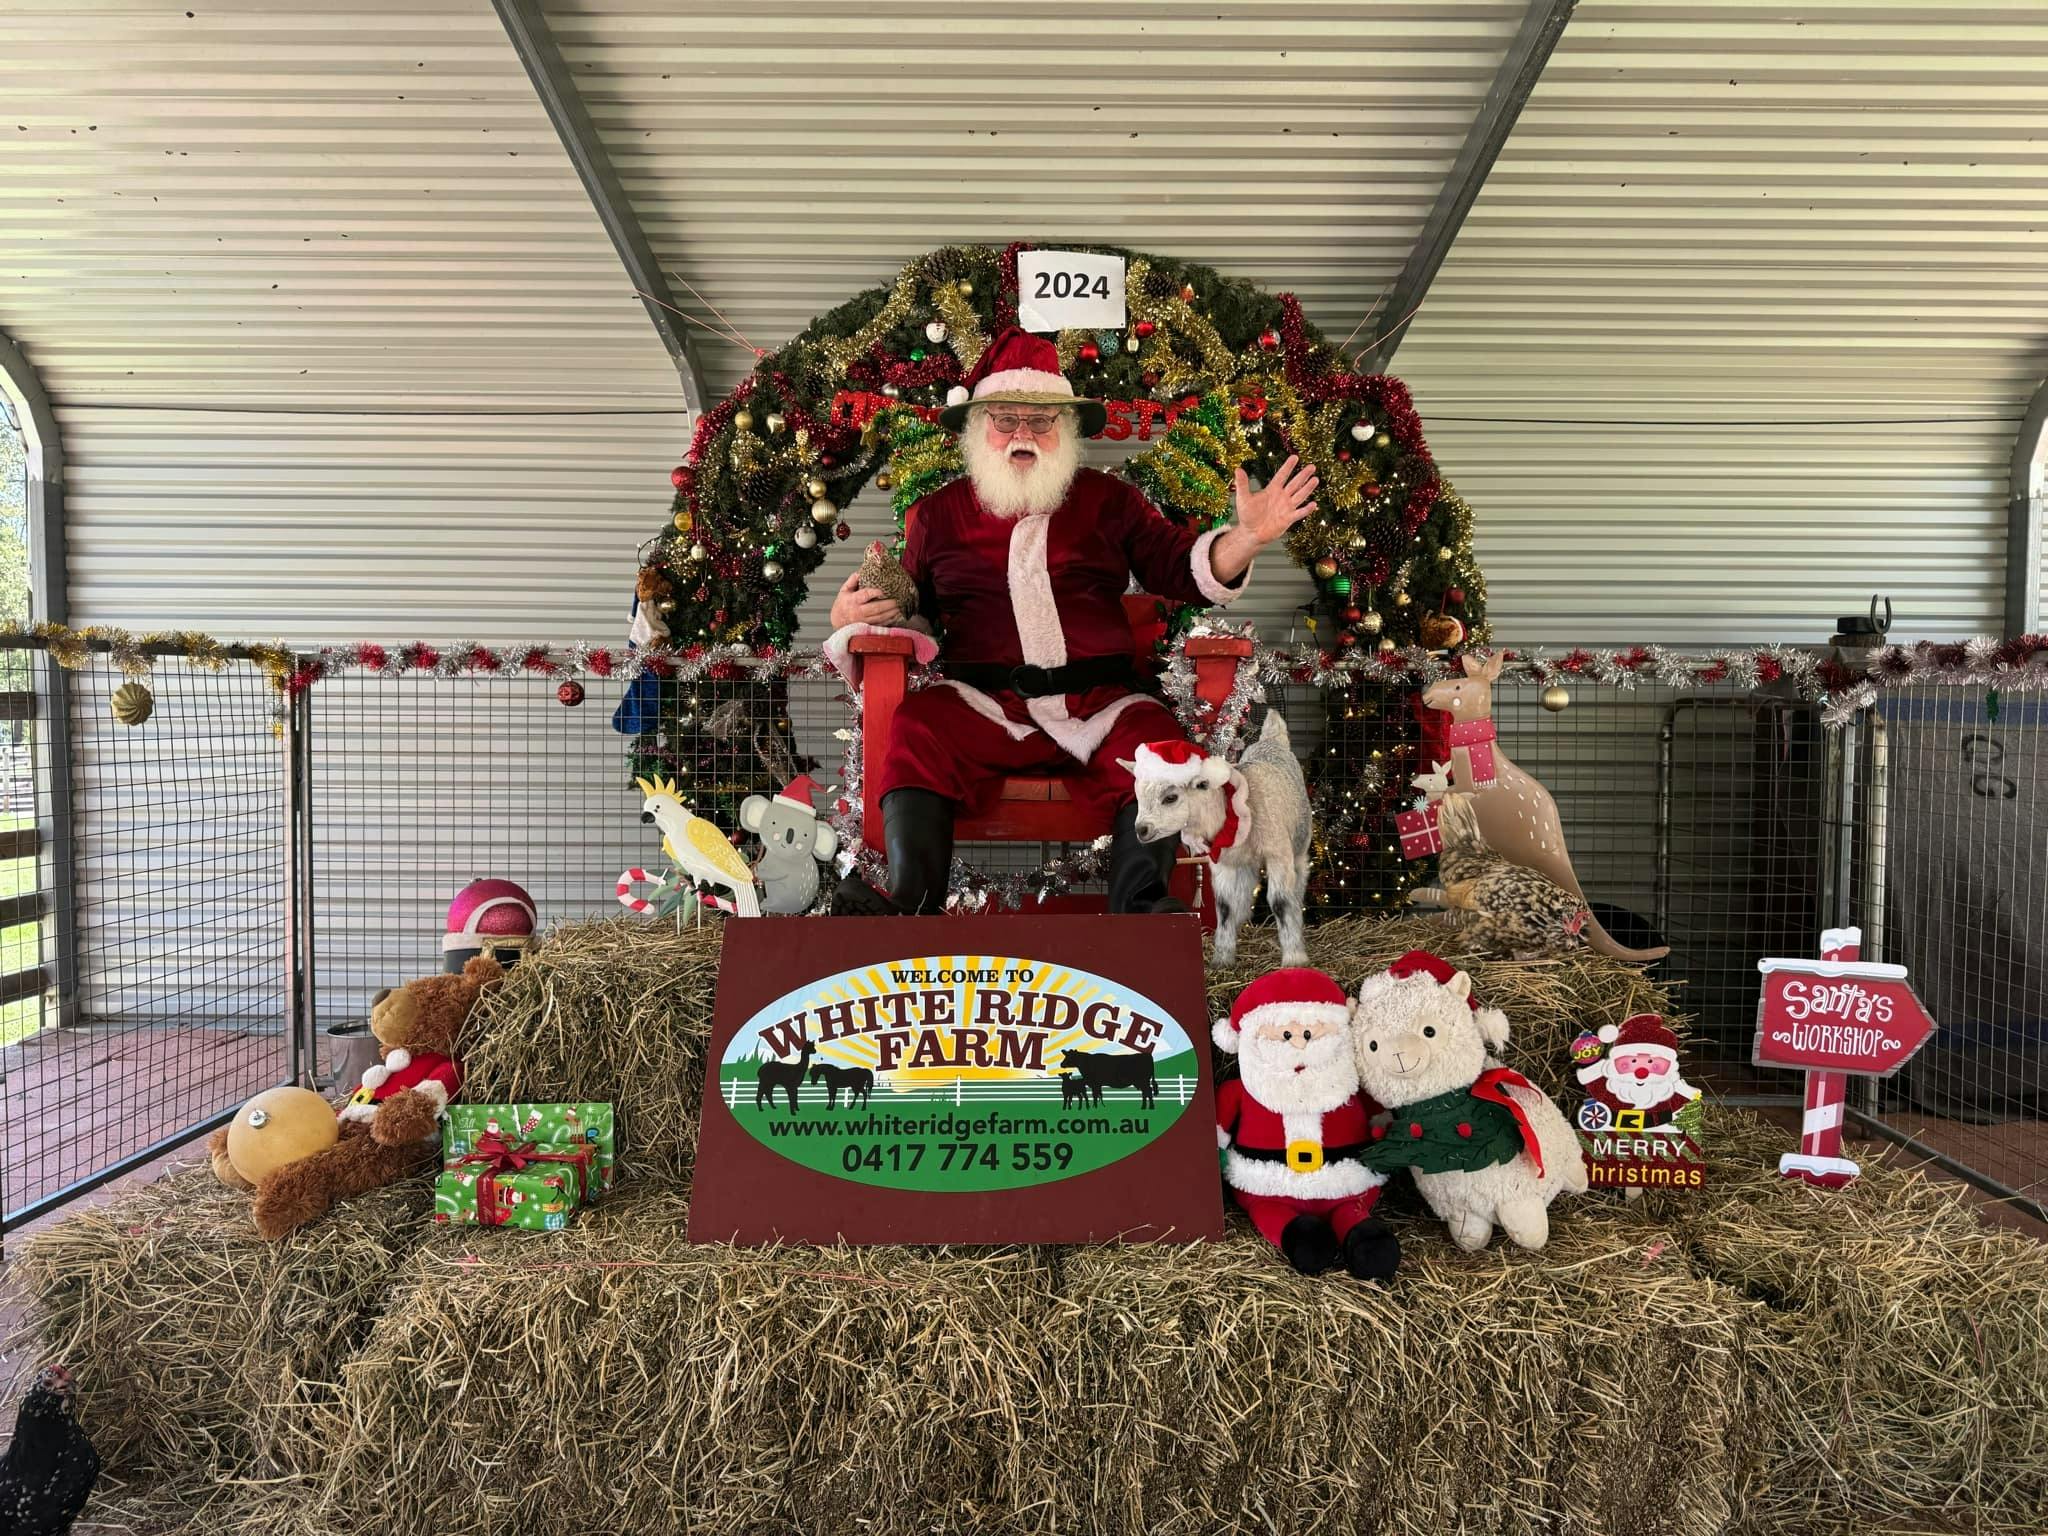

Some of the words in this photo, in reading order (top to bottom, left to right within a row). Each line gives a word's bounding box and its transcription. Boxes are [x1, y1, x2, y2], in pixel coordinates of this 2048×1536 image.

[1034, 271, 1111, 300] 2024
[891, 969, 999, 984] WELCOME
[1005, 968, 1034, 984] TO
[1782, 981, 1894, 1023] Santa's
[758, 988, 956, 1062] WHITE
[974, 988, 1164, 1053] RIDGE
[1792, 1021, 1884, 1057] WORKSHOP
[875, 1028, 1048, 1071] FARM
[1574, 1046, 1601, 1060] JOY
[768, 1112, 1150, 1141] www.whiteridgefarm.com.au
[842, 1144, 926, 1172] 0417
[937, 1144, 1000, 1171] 774
[1011, 1143, 1074, 1171] 559
[1593, 1138, 1686, 1157] MERRY
[1583, 1162, 1701, 1185] hristmas
